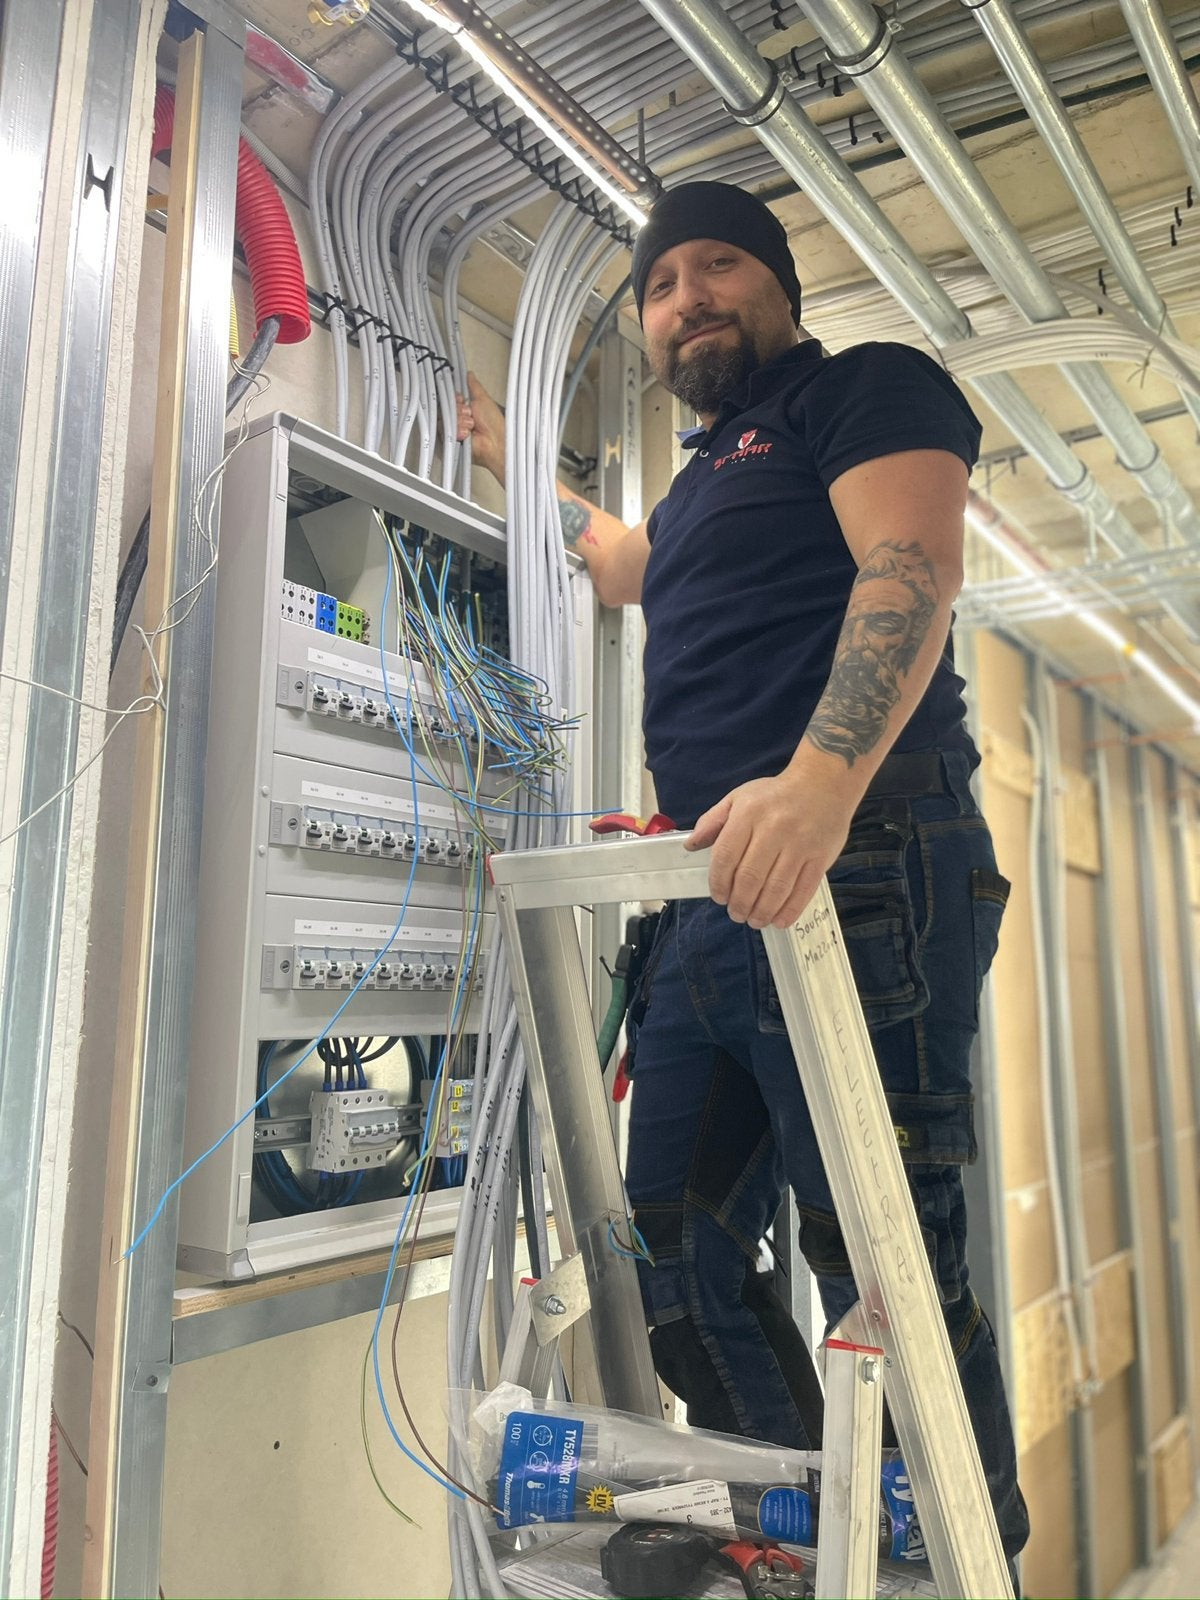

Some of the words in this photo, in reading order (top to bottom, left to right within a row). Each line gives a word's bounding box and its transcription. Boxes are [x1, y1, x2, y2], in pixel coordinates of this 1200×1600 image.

[510, 1422, 522, 1440] 100
[596, 1493, 608, 1509] UV
[686, 1514, 693, 1525] 3
